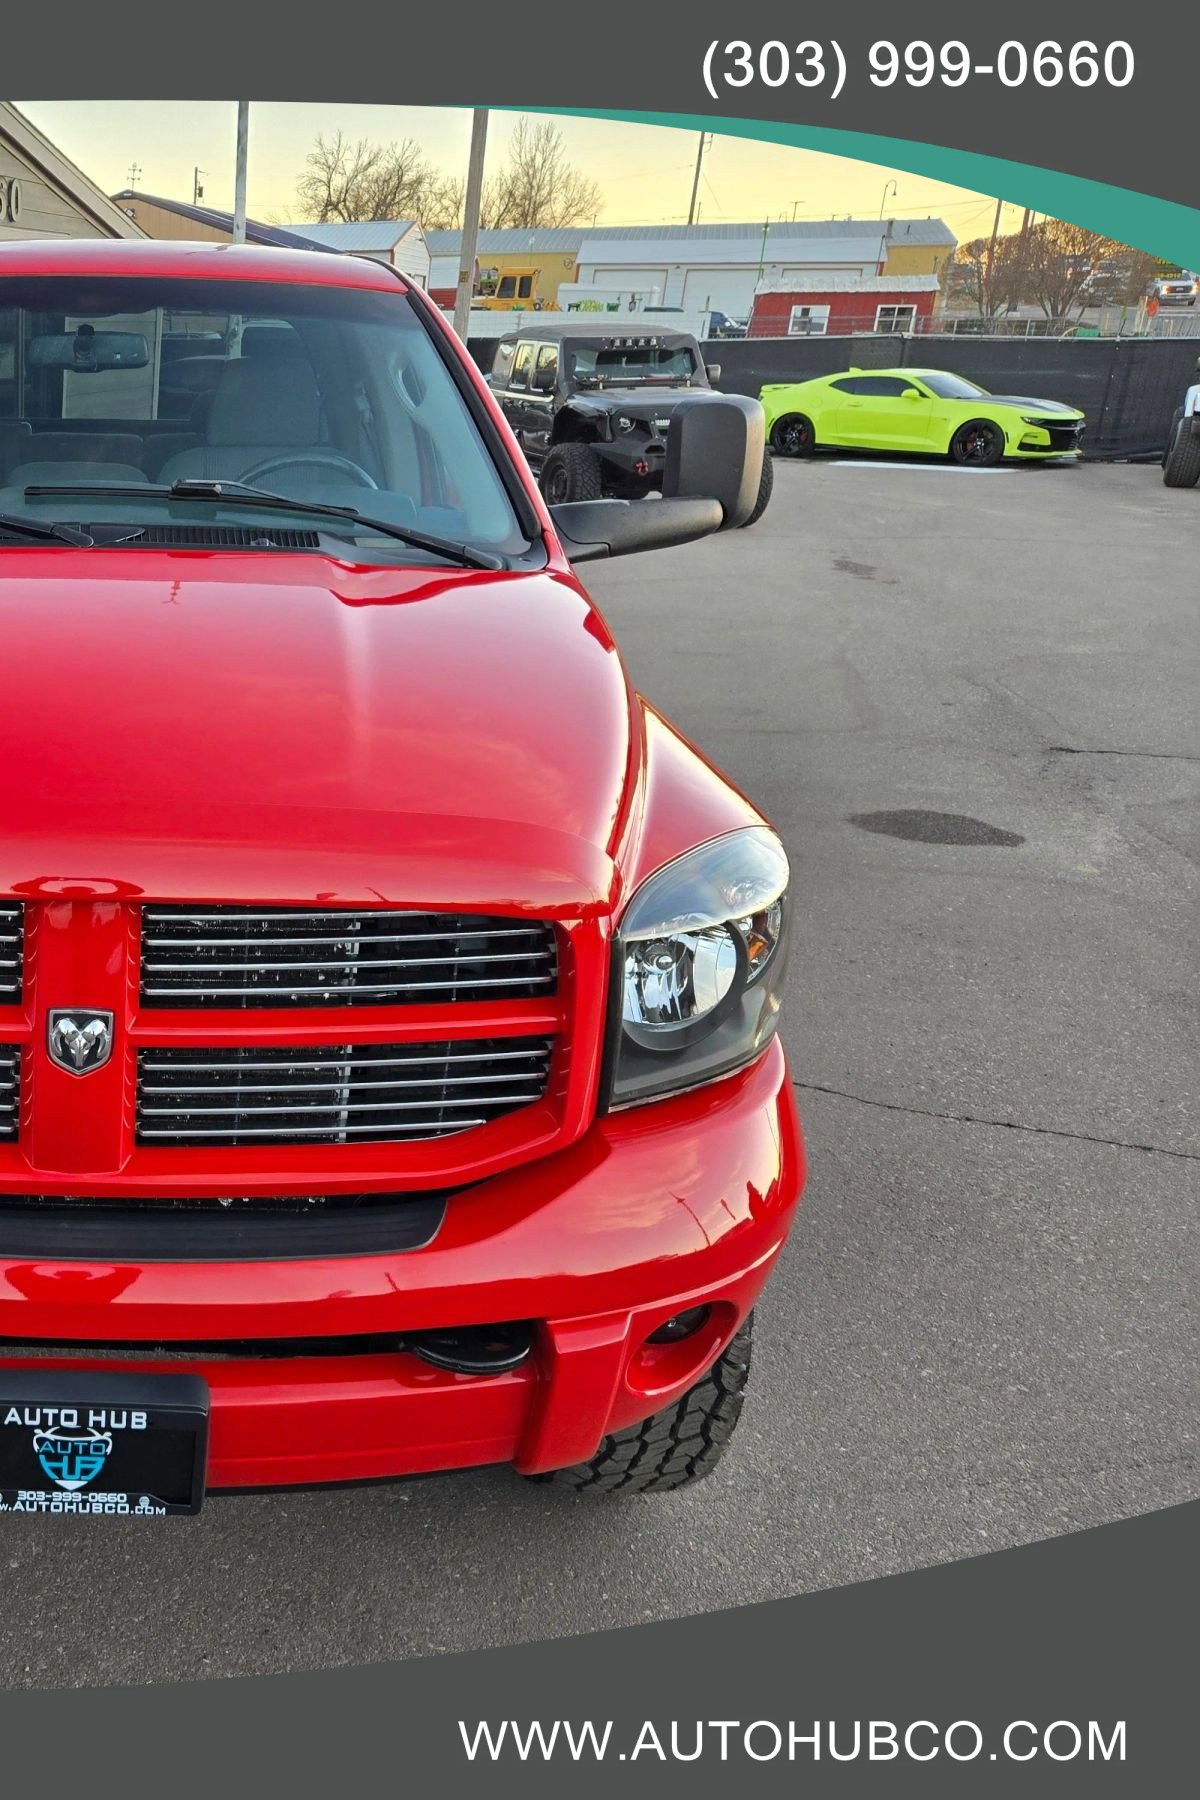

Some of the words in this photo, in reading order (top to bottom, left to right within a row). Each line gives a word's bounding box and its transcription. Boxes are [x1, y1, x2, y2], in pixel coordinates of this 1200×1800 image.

[4, 1407, 78, 1426] AUTO
[89, 1409, 148, 1429] HUB
[39, 1441, 106, 1455] AUTO
[39, 1455, 106, 1481] HUB
[17, 1491, 127, 1503] 303-999-0660
